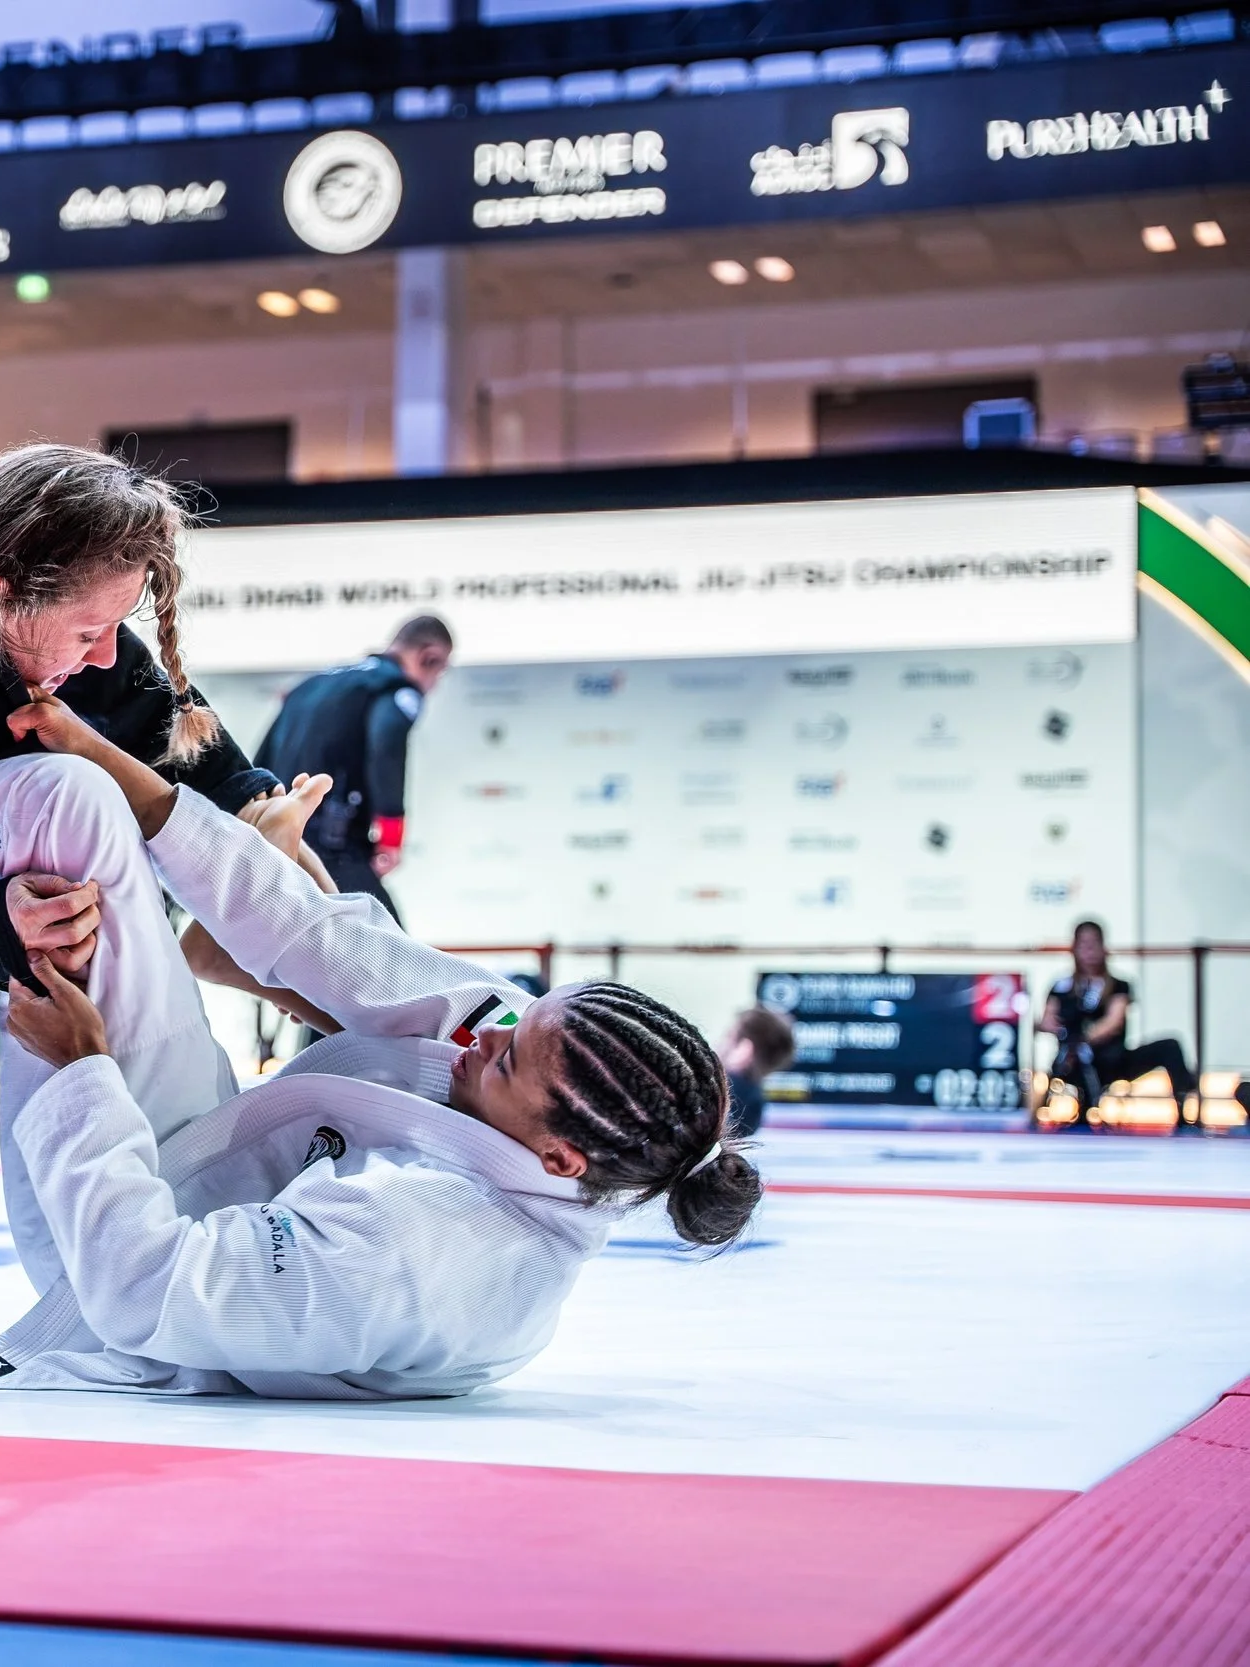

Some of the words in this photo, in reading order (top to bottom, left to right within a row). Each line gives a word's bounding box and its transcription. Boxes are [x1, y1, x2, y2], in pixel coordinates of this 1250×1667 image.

[473, 130, 668, 187] PREMIER
[978, 1021, 1016, 1069] 2
[260, 1203, 286, 1274] UBADALA
